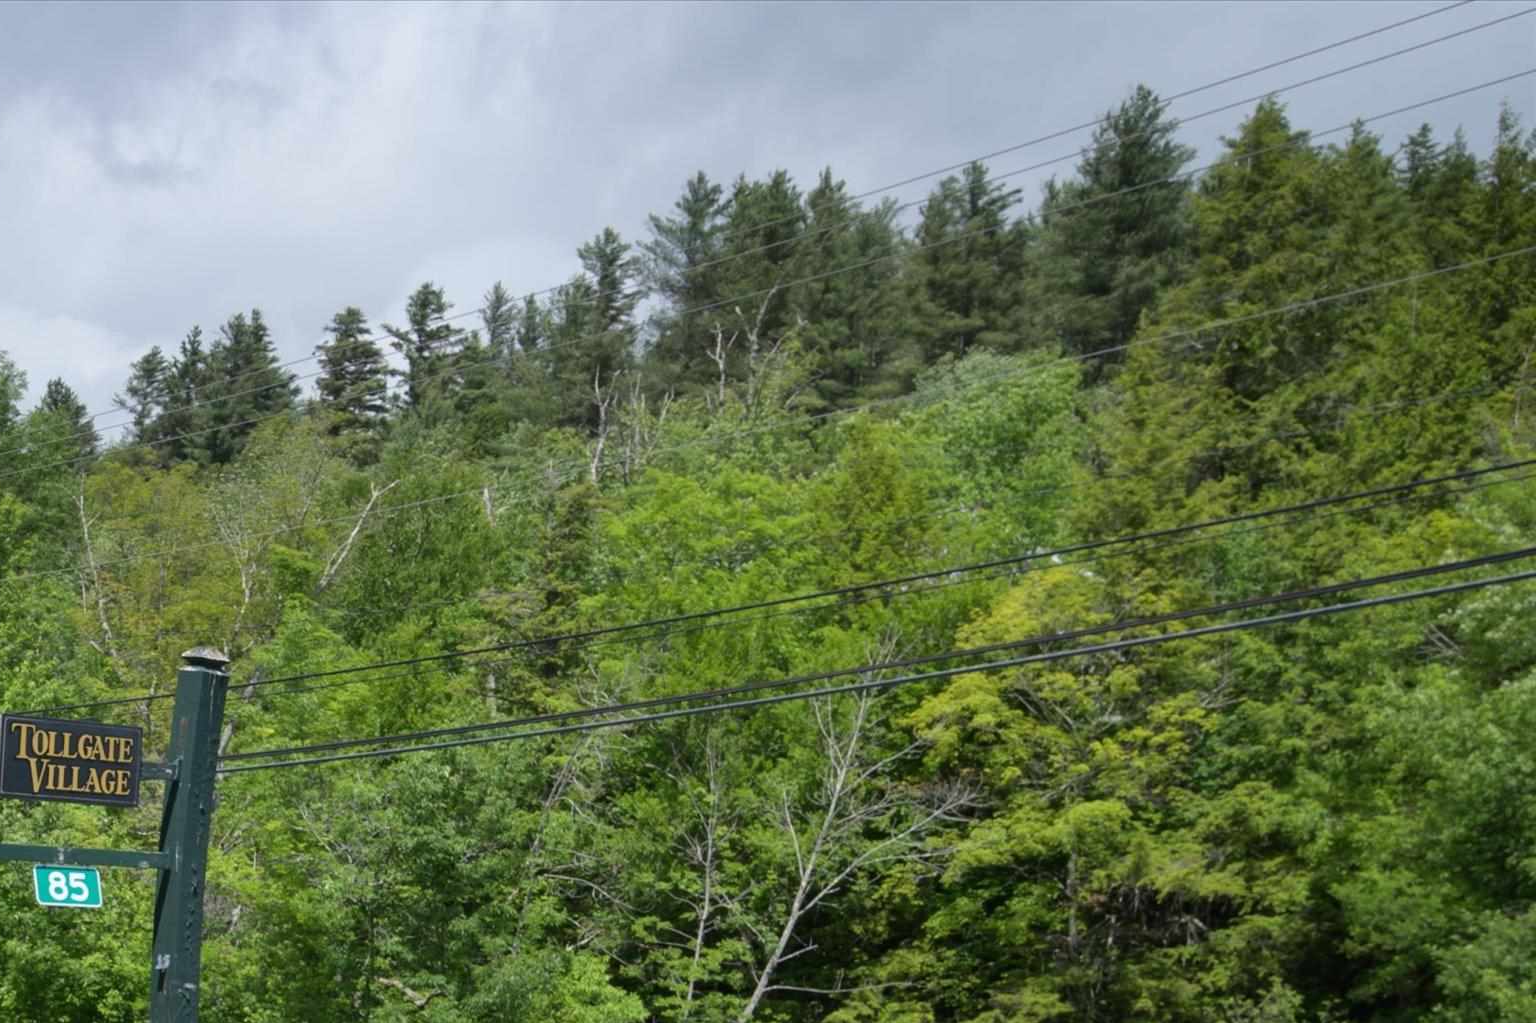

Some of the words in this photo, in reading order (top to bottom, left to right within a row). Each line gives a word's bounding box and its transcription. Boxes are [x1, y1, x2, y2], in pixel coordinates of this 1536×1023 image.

[11, 723, 134, 763] TOLLGATE
[28, 758, 131, 795] VILLAGE
[48, 871, 89, 902] 85
